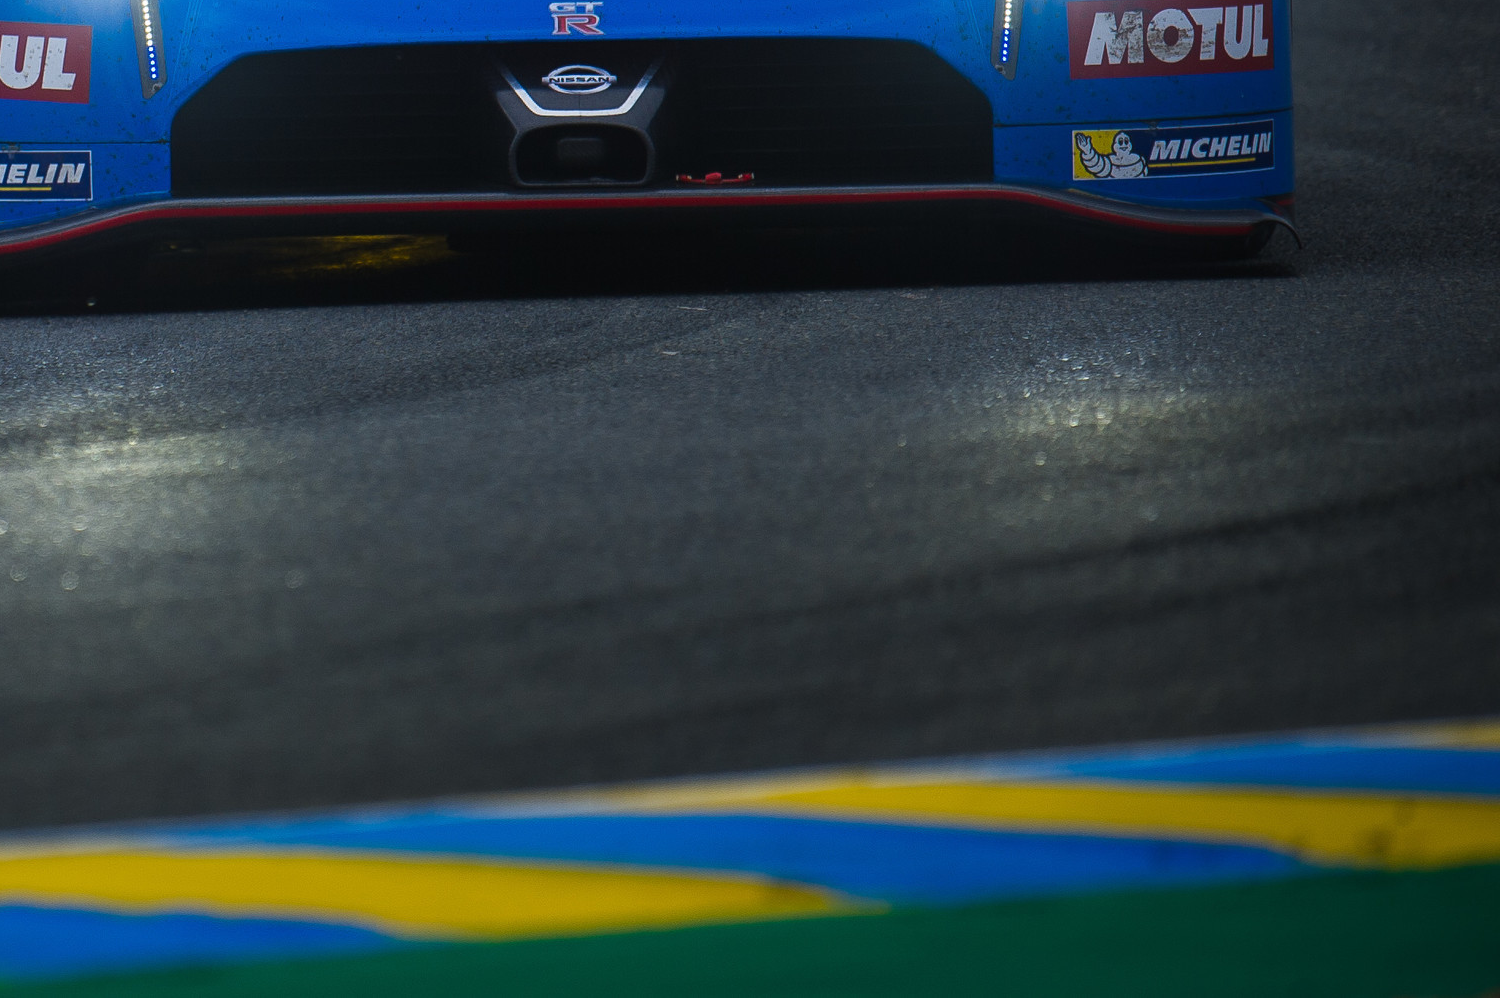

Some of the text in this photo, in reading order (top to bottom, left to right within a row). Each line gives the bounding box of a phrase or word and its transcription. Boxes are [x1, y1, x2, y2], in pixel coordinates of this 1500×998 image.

[548, 1, 605, 14] GT
[551, 13, 605, 36] R
[1083, 3, 1269, 66] MOTUL
[547, 75, 611, 84] NISSAN
[1149, 131, 1272, 161] MICHELIN
